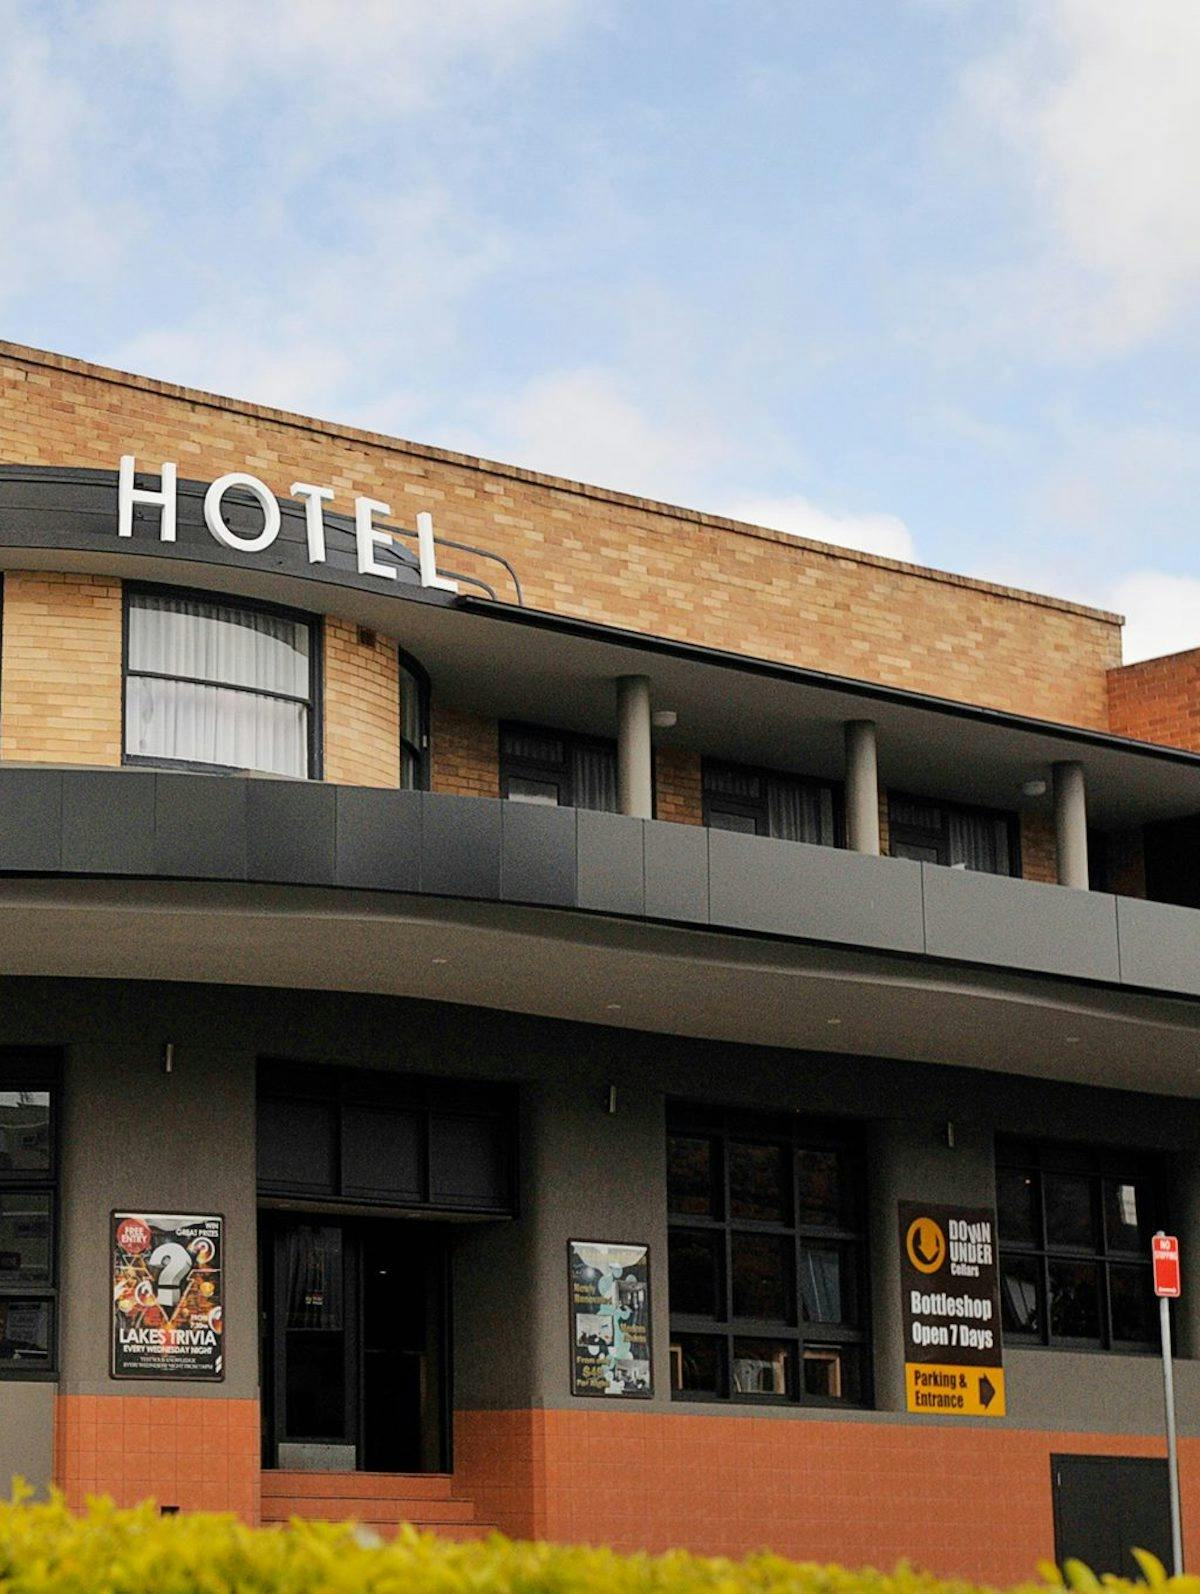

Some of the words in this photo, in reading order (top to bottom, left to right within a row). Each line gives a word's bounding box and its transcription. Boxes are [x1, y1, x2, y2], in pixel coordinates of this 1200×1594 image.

[118, 454, 458, 594] HOTEL
[949, 1219, 991, 1244] DOWN
[949, 1241, 993, 1265] UNDER
[950, 1262, 980, 1278] Cellars
[911, 1290, 992, 1321] Bottleshop
[119, 1328, 167, 1345] LAKES
[170, 1329, 217, 1346] TRIVIA
[912, 1321, 948, 1346] Open
[949, 1323, 958, 1346] 7
[959, 1324, 993, 1350] Days
[123, 1345, 146, 1353] EVERY
[146, 1345, 190, 1354] WEDNESDAY
[914, 1370, 956, 1389] Parking
[959, 1374, 967, 1388] &
[914, 1390, 964, 1408] Entrance
